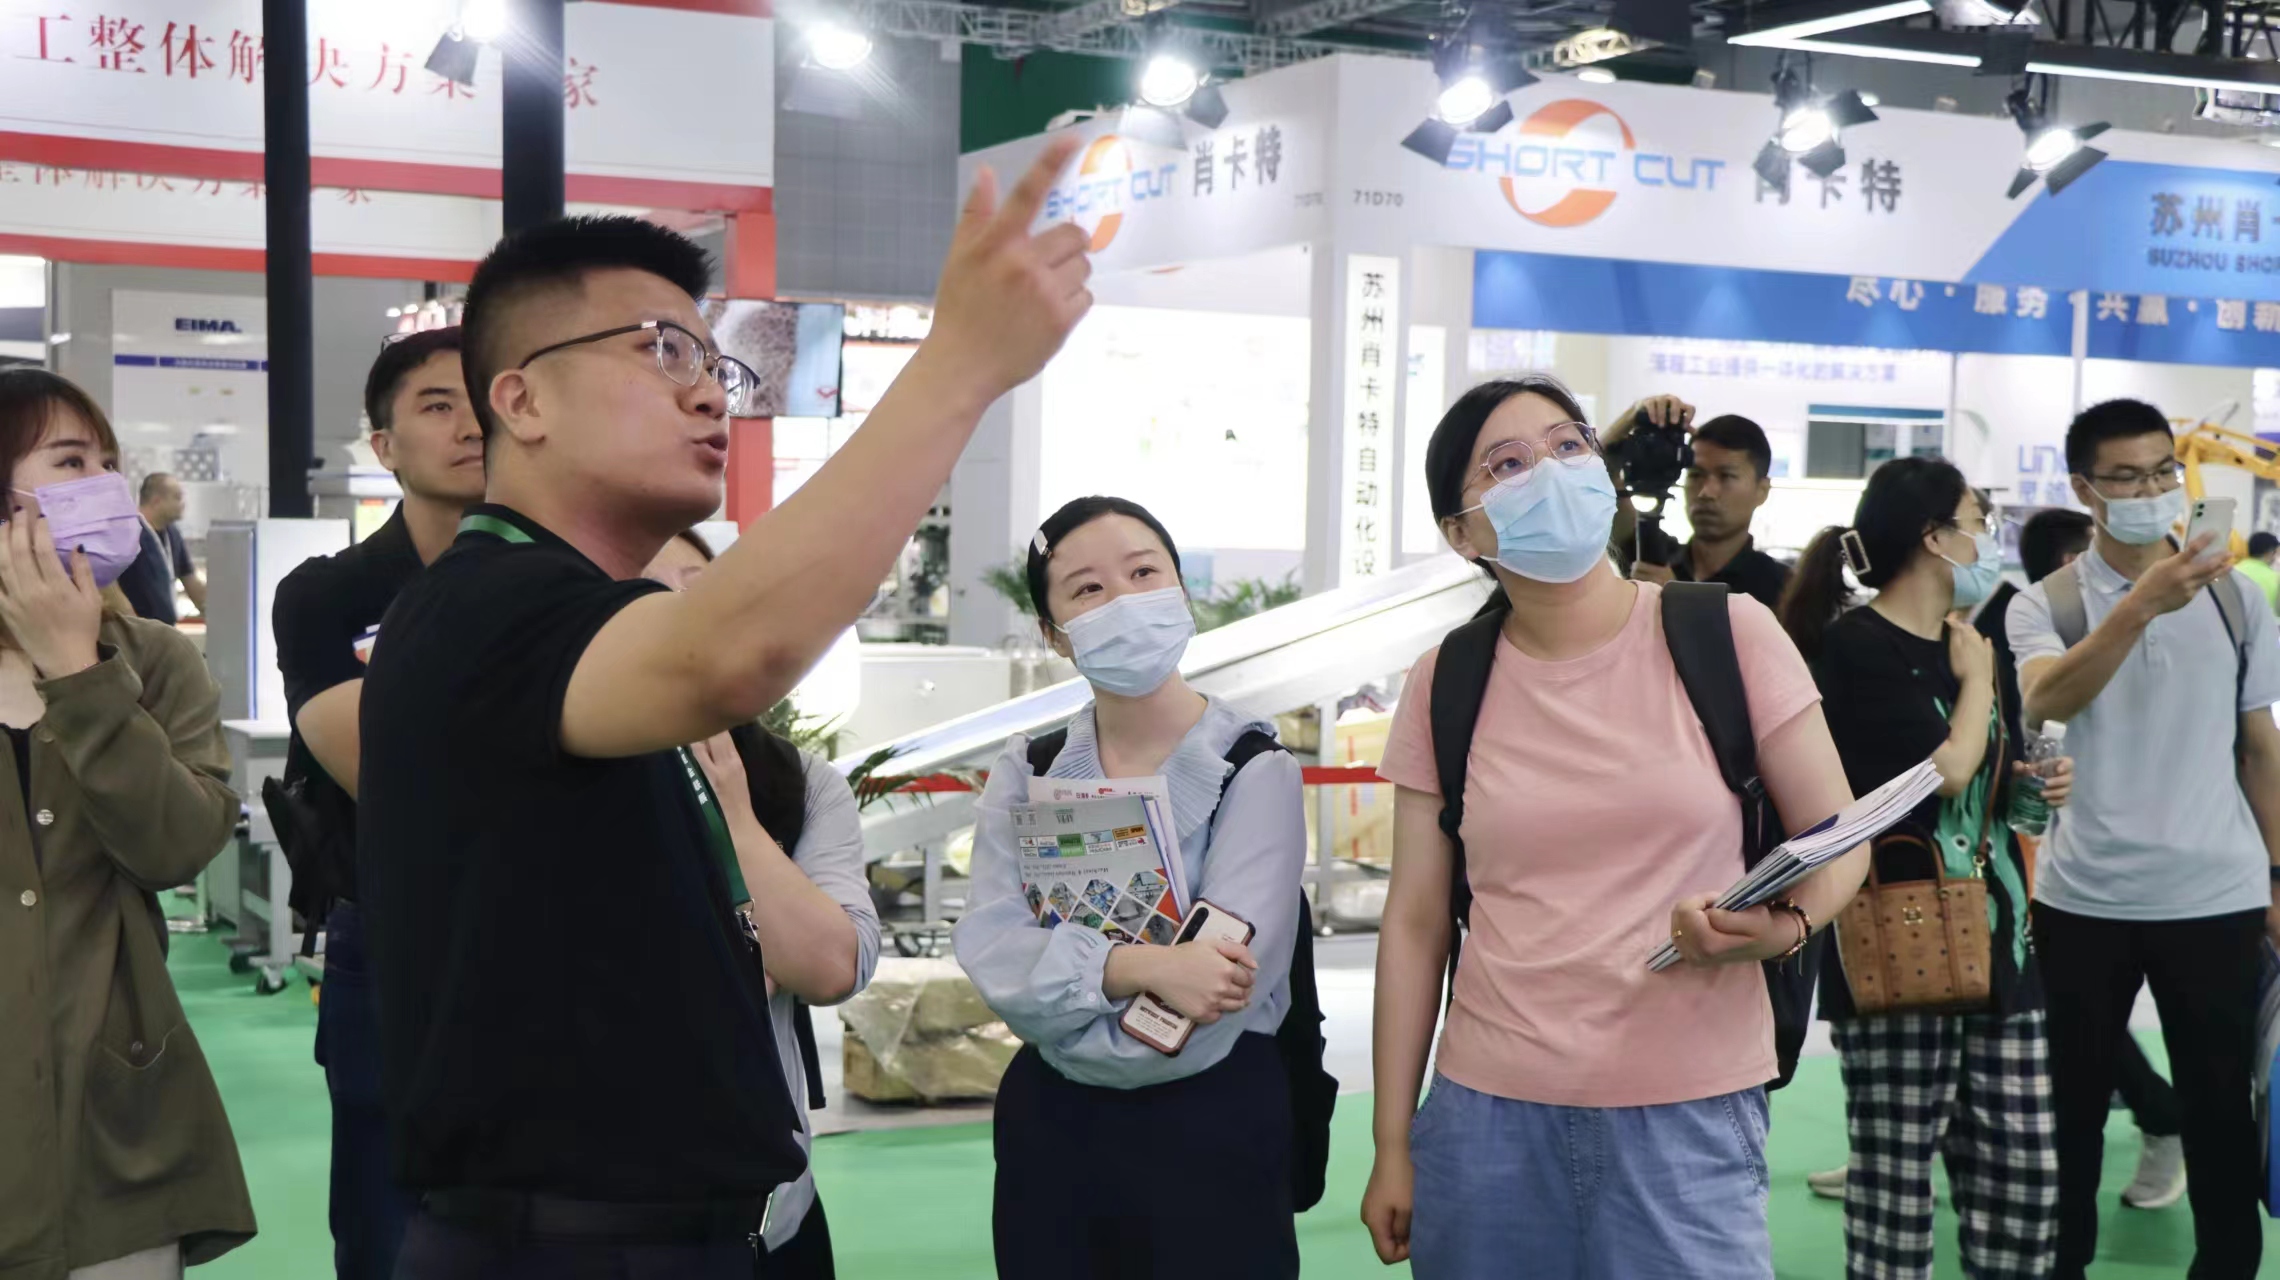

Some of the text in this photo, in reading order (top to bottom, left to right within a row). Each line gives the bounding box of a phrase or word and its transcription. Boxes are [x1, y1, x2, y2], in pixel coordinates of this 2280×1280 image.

[1193, 123, 1282, 198] 肖卡特
[1447, 137, 1725, 191] SHORT CUT
[1131, 163, 1178, 202] CUT
[1353, 188, 1404, 208] 71D70
[2148, 248, 2229, 272] SUZHOU
